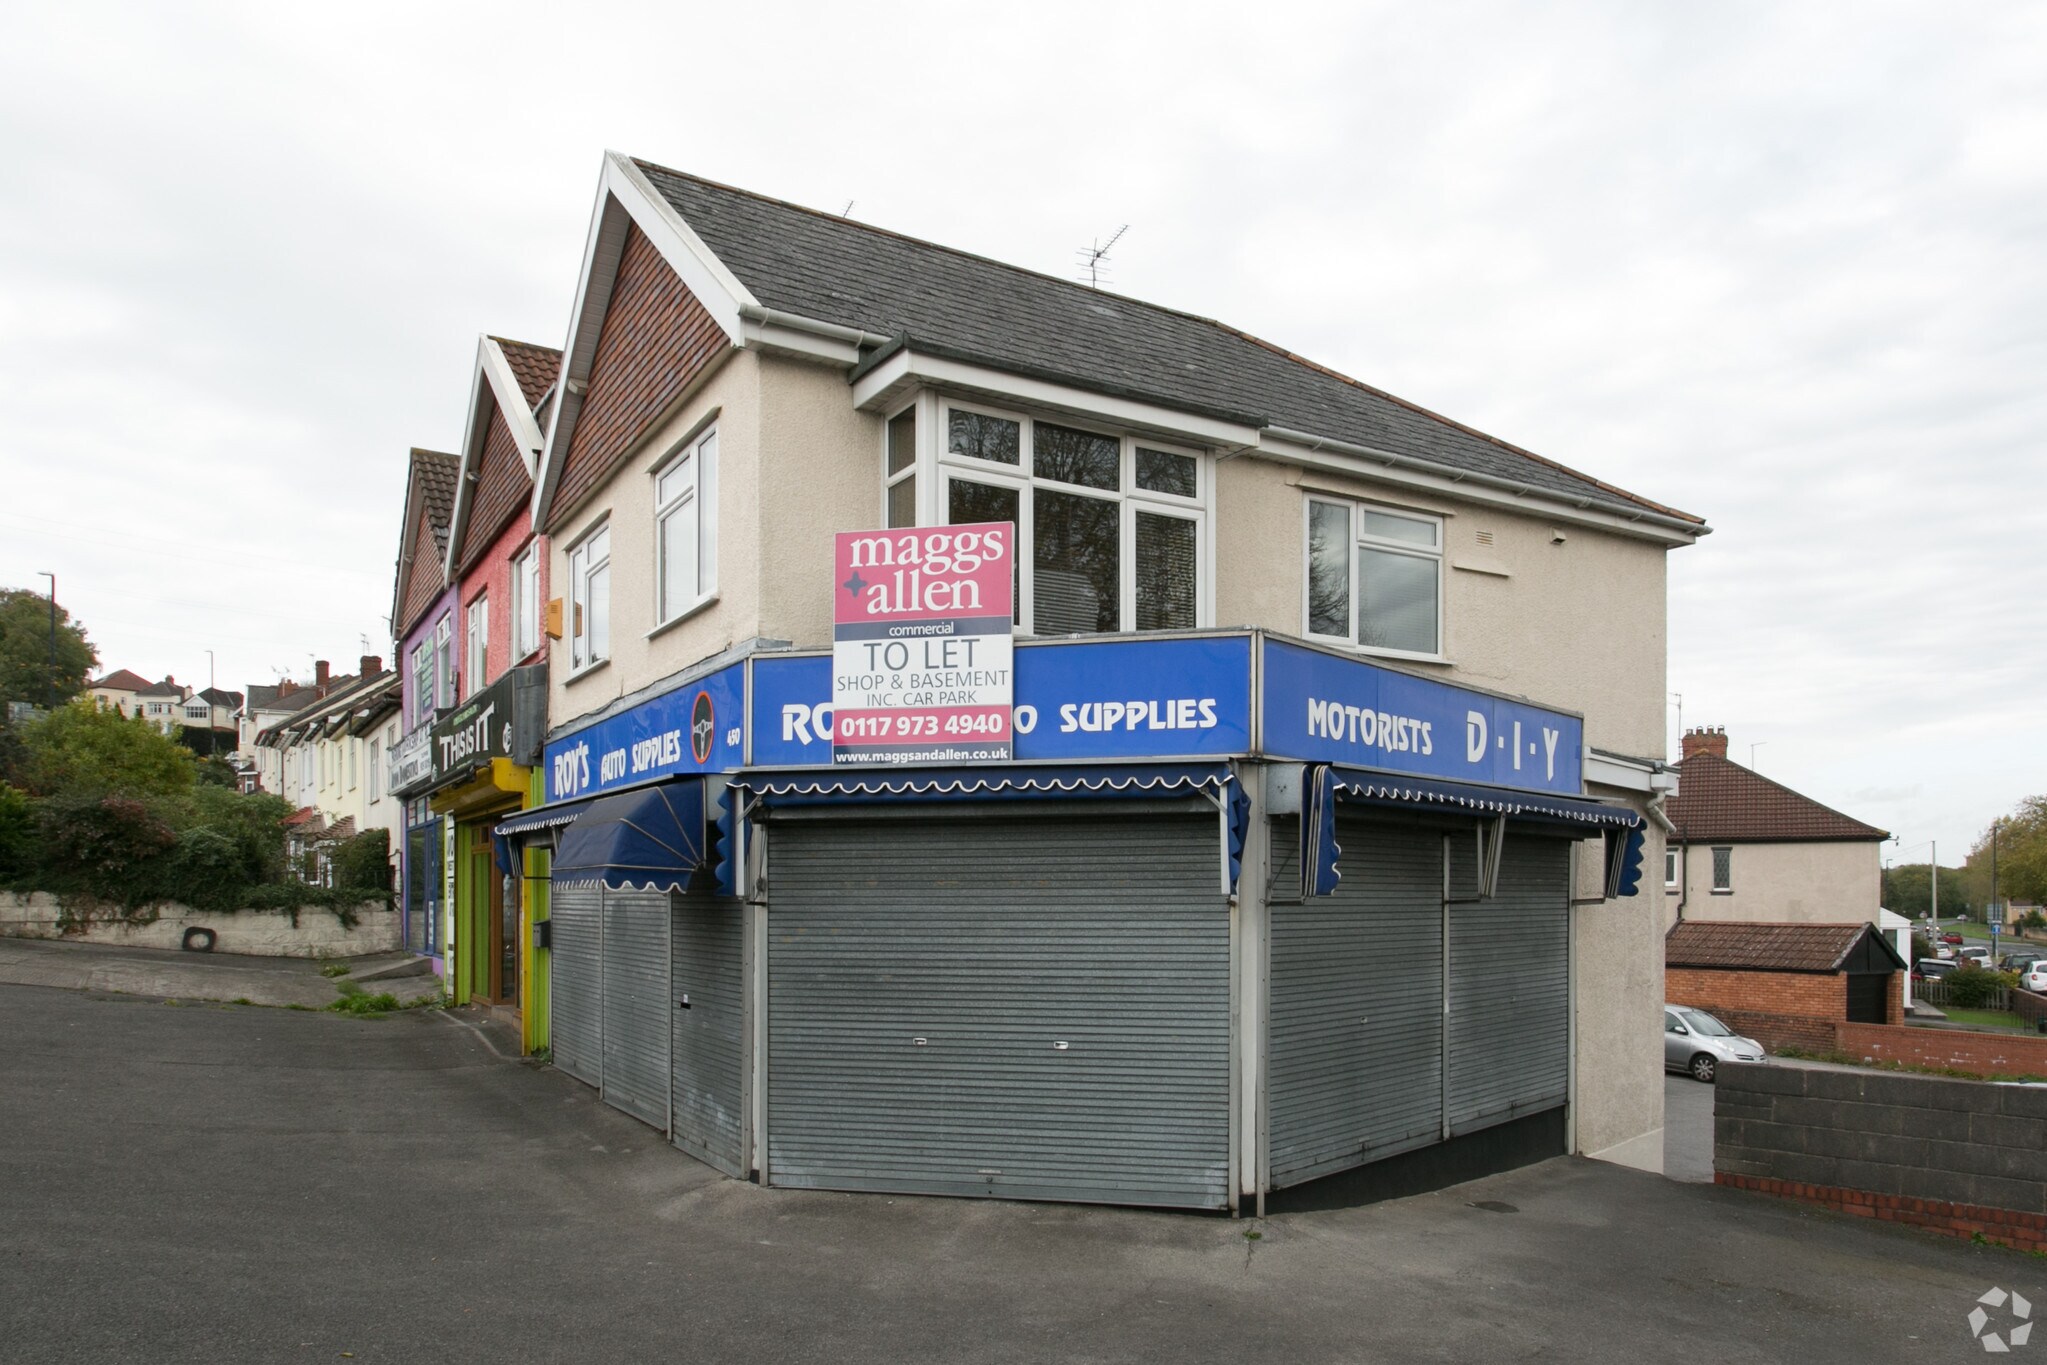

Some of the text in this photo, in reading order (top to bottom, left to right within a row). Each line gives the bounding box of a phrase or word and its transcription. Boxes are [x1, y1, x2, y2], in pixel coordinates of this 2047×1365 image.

[850, 530, 1004, 576] maggs
[866, 568, 983, 614] allen
[889, 621, 954, 637] commercial
[863, 638, 980, 671] TO LET
[837, 670, 1008, 691] SHOP & BASEMENT
[866, 690, 978, 707] INC. CAR PARK
[1060, 698, 1217, 733] SUPPLIES
[475, 700, 495, 752] IT
[841, 713, 1003, 737] 0117 973 4940
[1308, 697, 1433, 755] MOTORISTS
[554, 740, 590, 799] ROY'S
[601, 747, 626, 786] AUTO
[632, 729, 681, 774] SUPPLIES
[836, 747, 1008, 764] www.maggsandallen.co.uk
